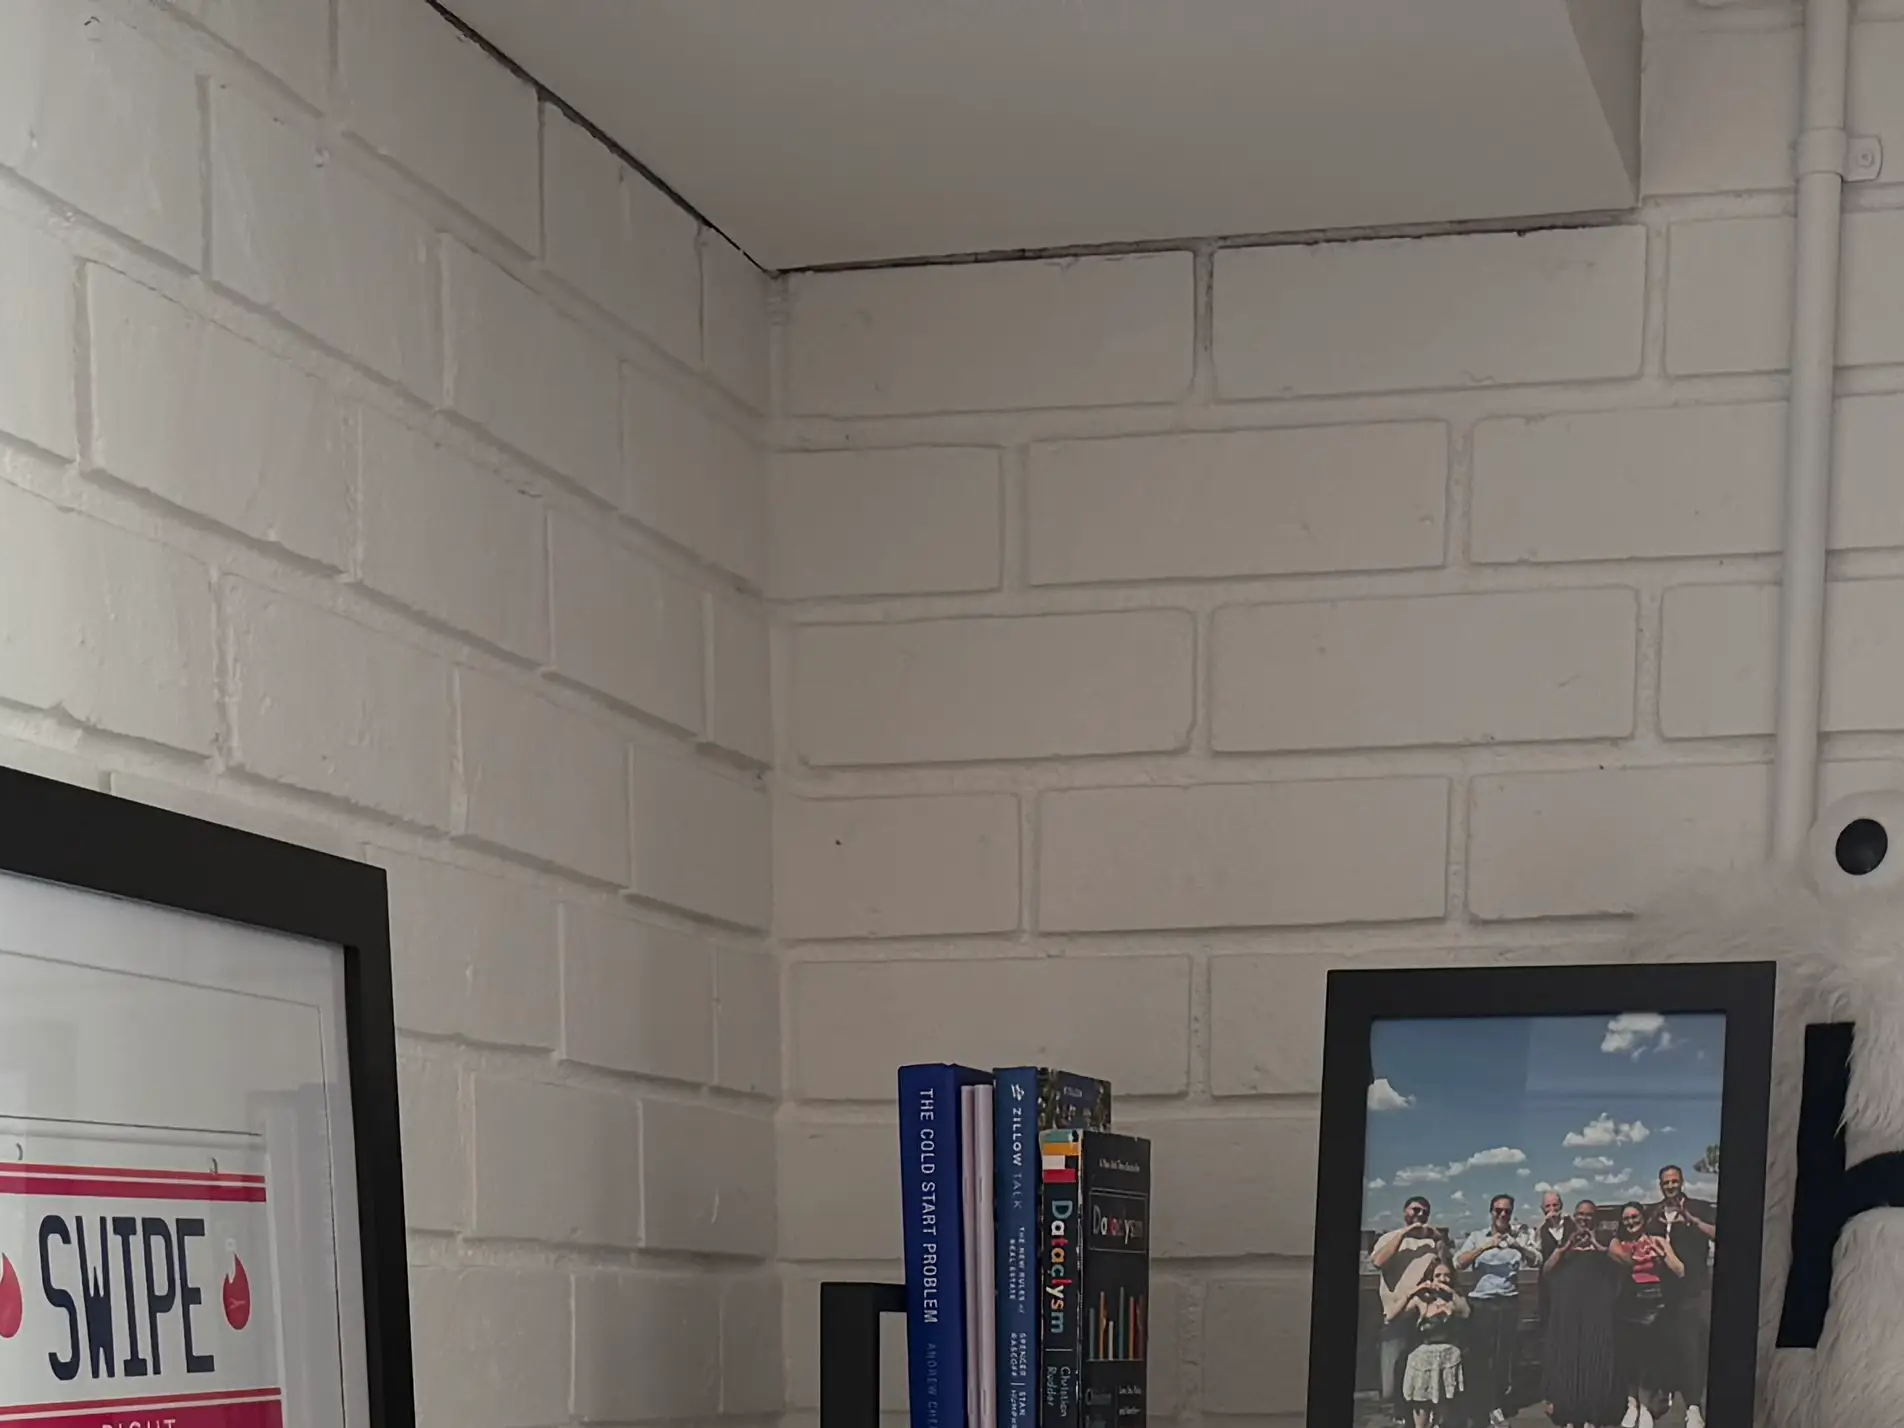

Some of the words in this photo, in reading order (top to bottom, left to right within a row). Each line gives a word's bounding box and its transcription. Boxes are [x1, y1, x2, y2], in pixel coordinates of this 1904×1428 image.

[919, 1088, 934, 1121] THE
[920, 1128, 935, 1174] COLD
[1013, 1107, 1022, 1166] ZILLOW
[921, 1182, 937, 1236] START
[1012, 1173, 1022, 1209] TALK
[923, 1243, 938, 1323] PROBLEM
[1046, 1200, 1073, 1334] Dataclysm
[38, 1215, 215, 1381] SWIPE
